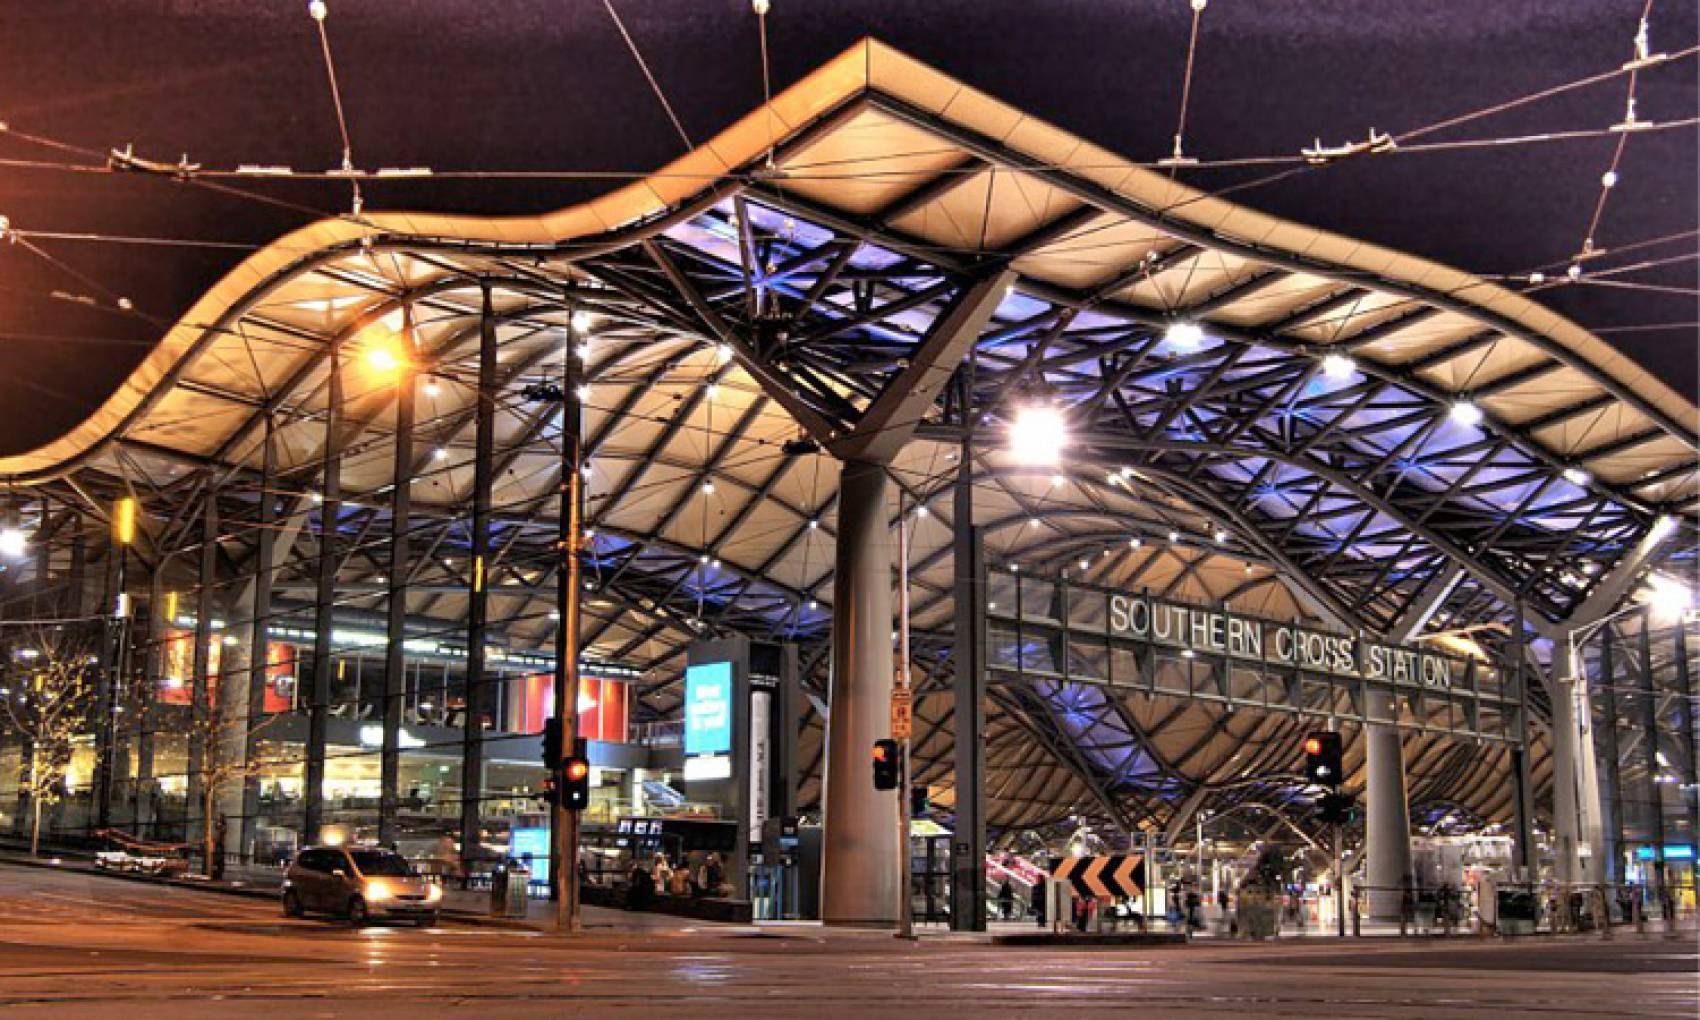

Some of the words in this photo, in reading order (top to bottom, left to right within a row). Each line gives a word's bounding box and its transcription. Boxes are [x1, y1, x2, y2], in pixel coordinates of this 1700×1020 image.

[1110, 596, 1263, 657] SOUTHERN
[1275, 627, 1354, 672] CROSS
[1370, 645, 1452, 689] STATION
